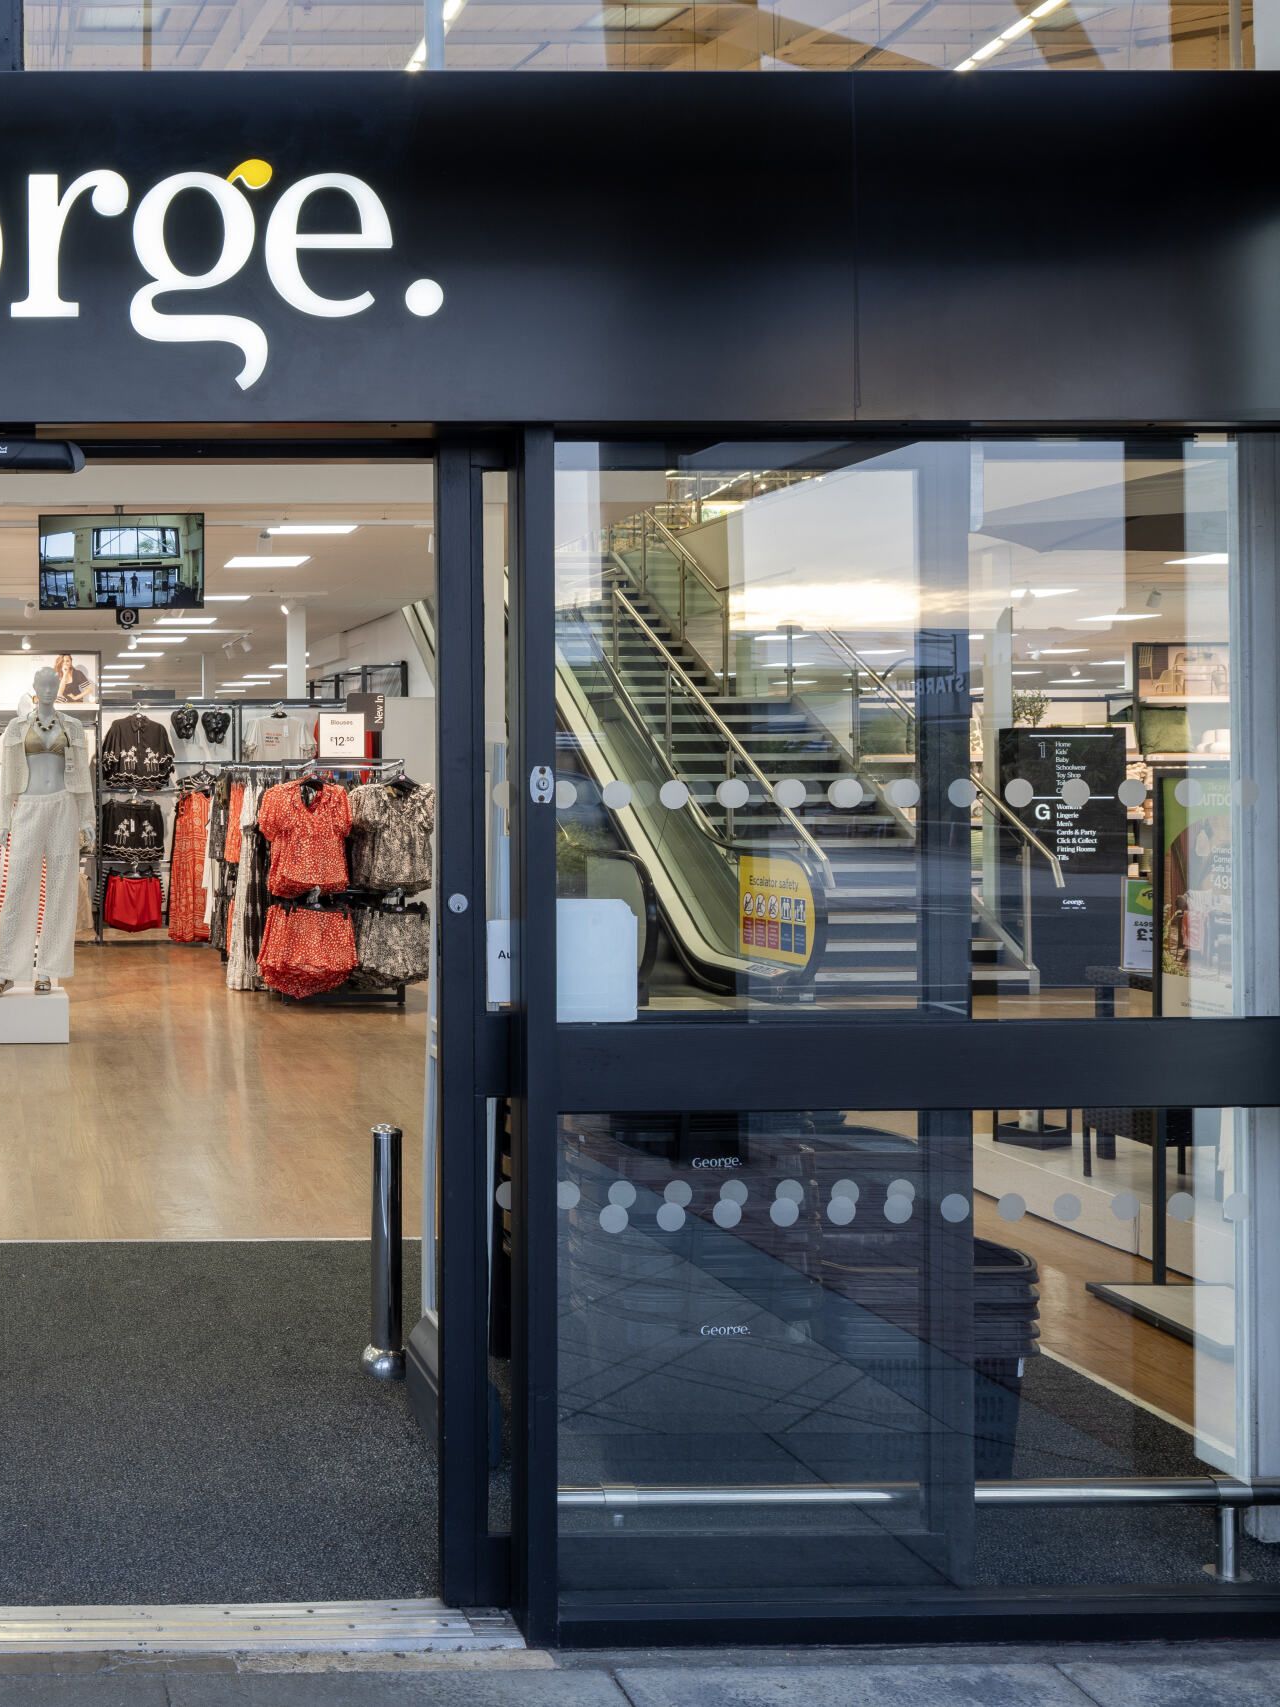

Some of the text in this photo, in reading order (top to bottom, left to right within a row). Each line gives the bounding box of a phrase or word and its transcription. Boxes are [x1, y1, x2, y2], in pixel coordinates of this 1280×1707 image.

[374, 695, 384, 724] New In
[1038, 741, 1046, 759] 1
[1035, 803, 1051, 820] G
[1056, 812, 1079, 820] Lingerie
[1080, 829, 1096, 837] Party
[1056, 846, 1075, 854] Fitting
[749, 875, 799, 893] Escalator safety
[691, 1156, 743, 1169] George.
